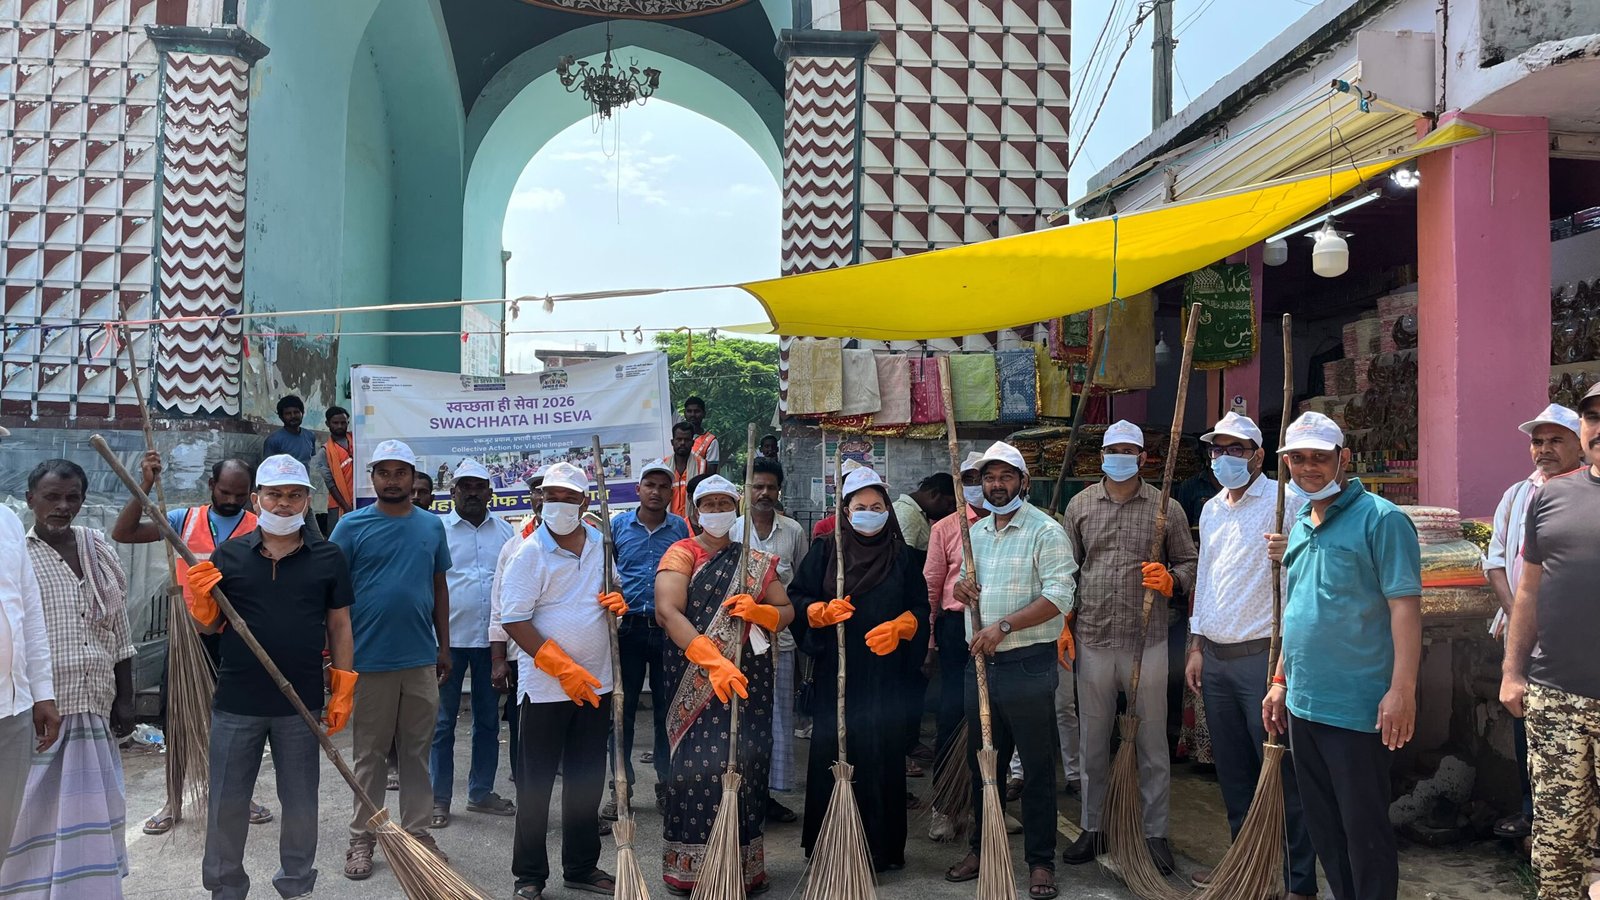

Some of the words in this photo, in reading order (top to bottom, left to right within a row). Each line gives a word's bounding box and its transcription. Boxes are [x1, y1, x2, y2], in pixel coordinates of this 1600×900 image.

[446, 401, 494, 413] स्वच्छता
[498, 397, 510, 412] ही
[514, 396, 538, 410] सेवा
[543, 396, 575, 408] 2026
[430, 414, 529, 430] SWACHHATA
[534, 413, 548, 425] HI
[553, 410, 592, 424] SEVA
